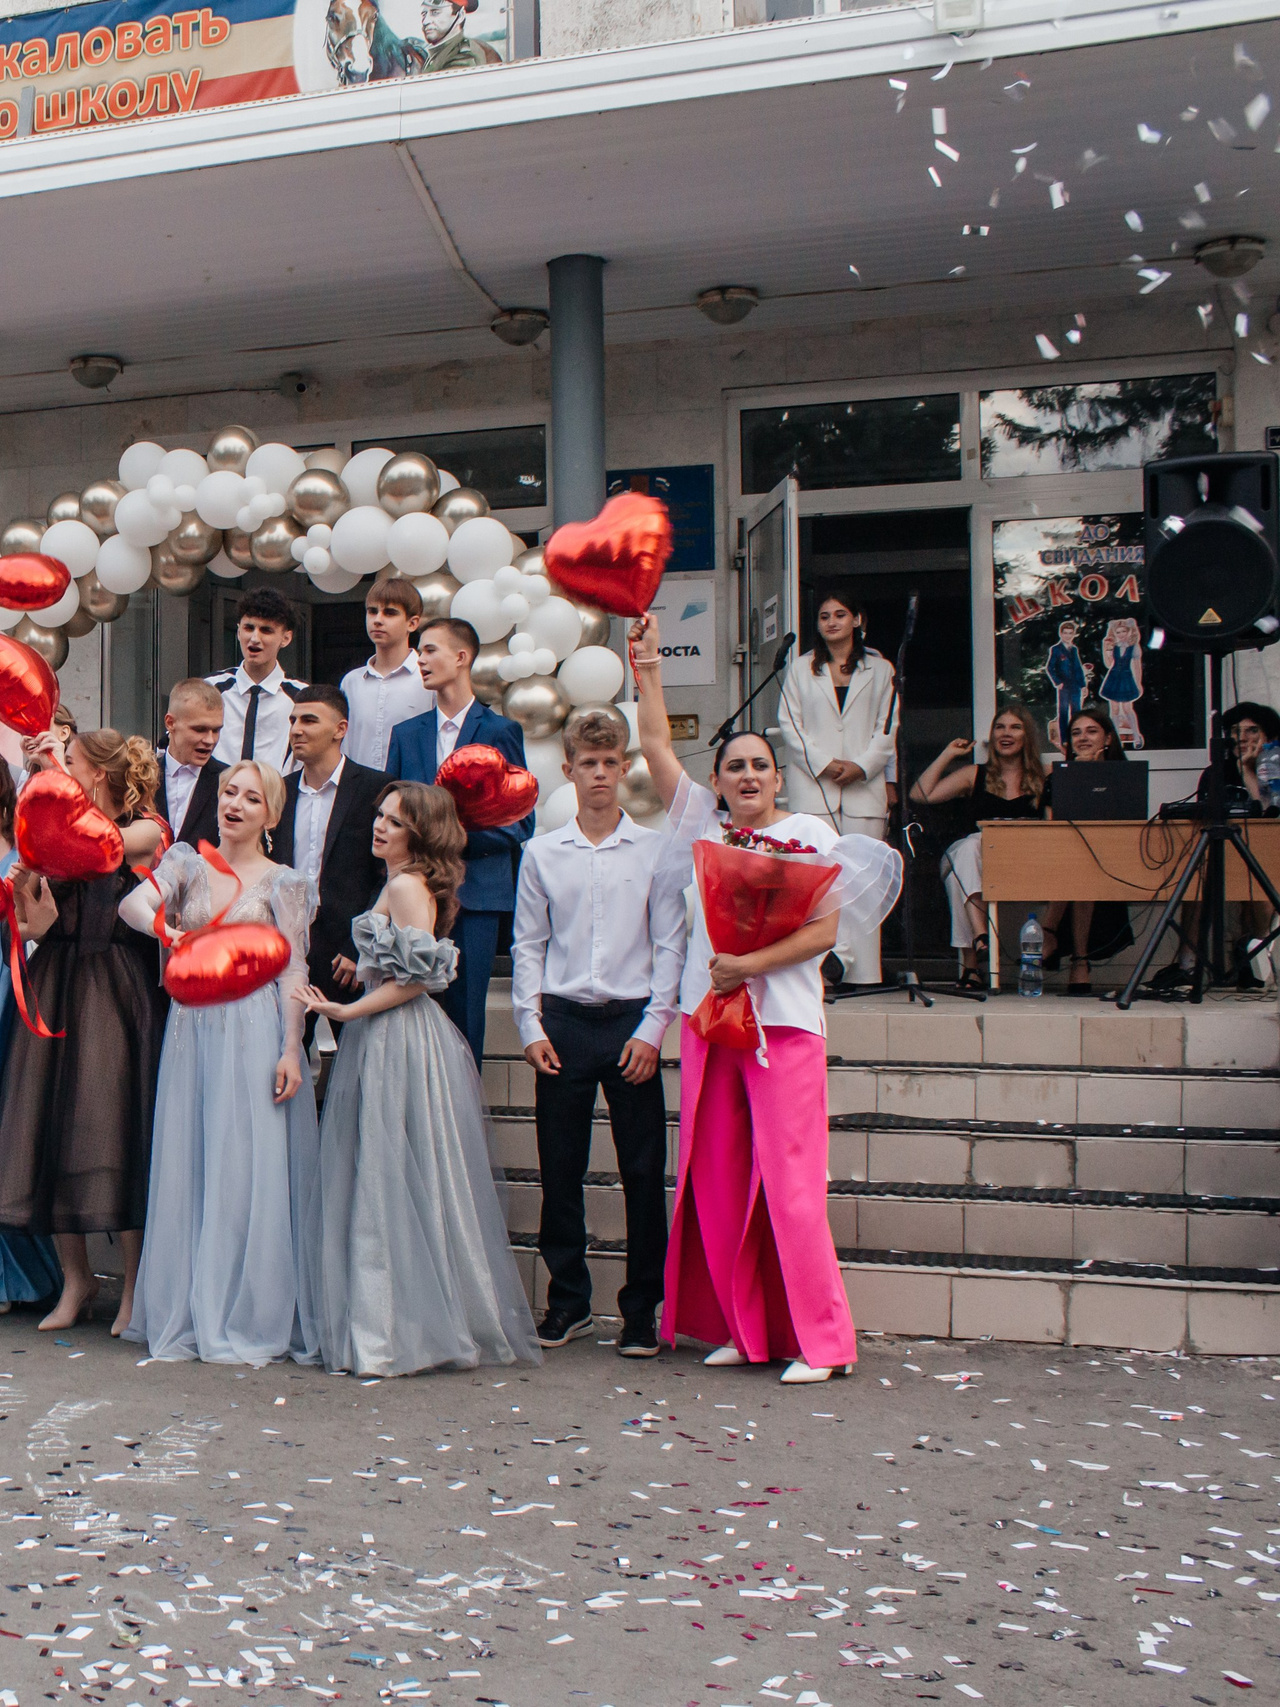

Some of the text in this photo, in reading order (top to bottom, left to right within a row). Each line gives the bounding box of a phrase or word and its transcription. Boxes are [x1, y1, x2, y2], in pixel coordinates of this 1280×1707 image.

[34, 67, 203, 132] школу
[1079, 523, 1111, 543] ДО
[1038, 544, 1146, 567] СВИДАНИЯ
[657, 645, 701, 658] ОСТА
